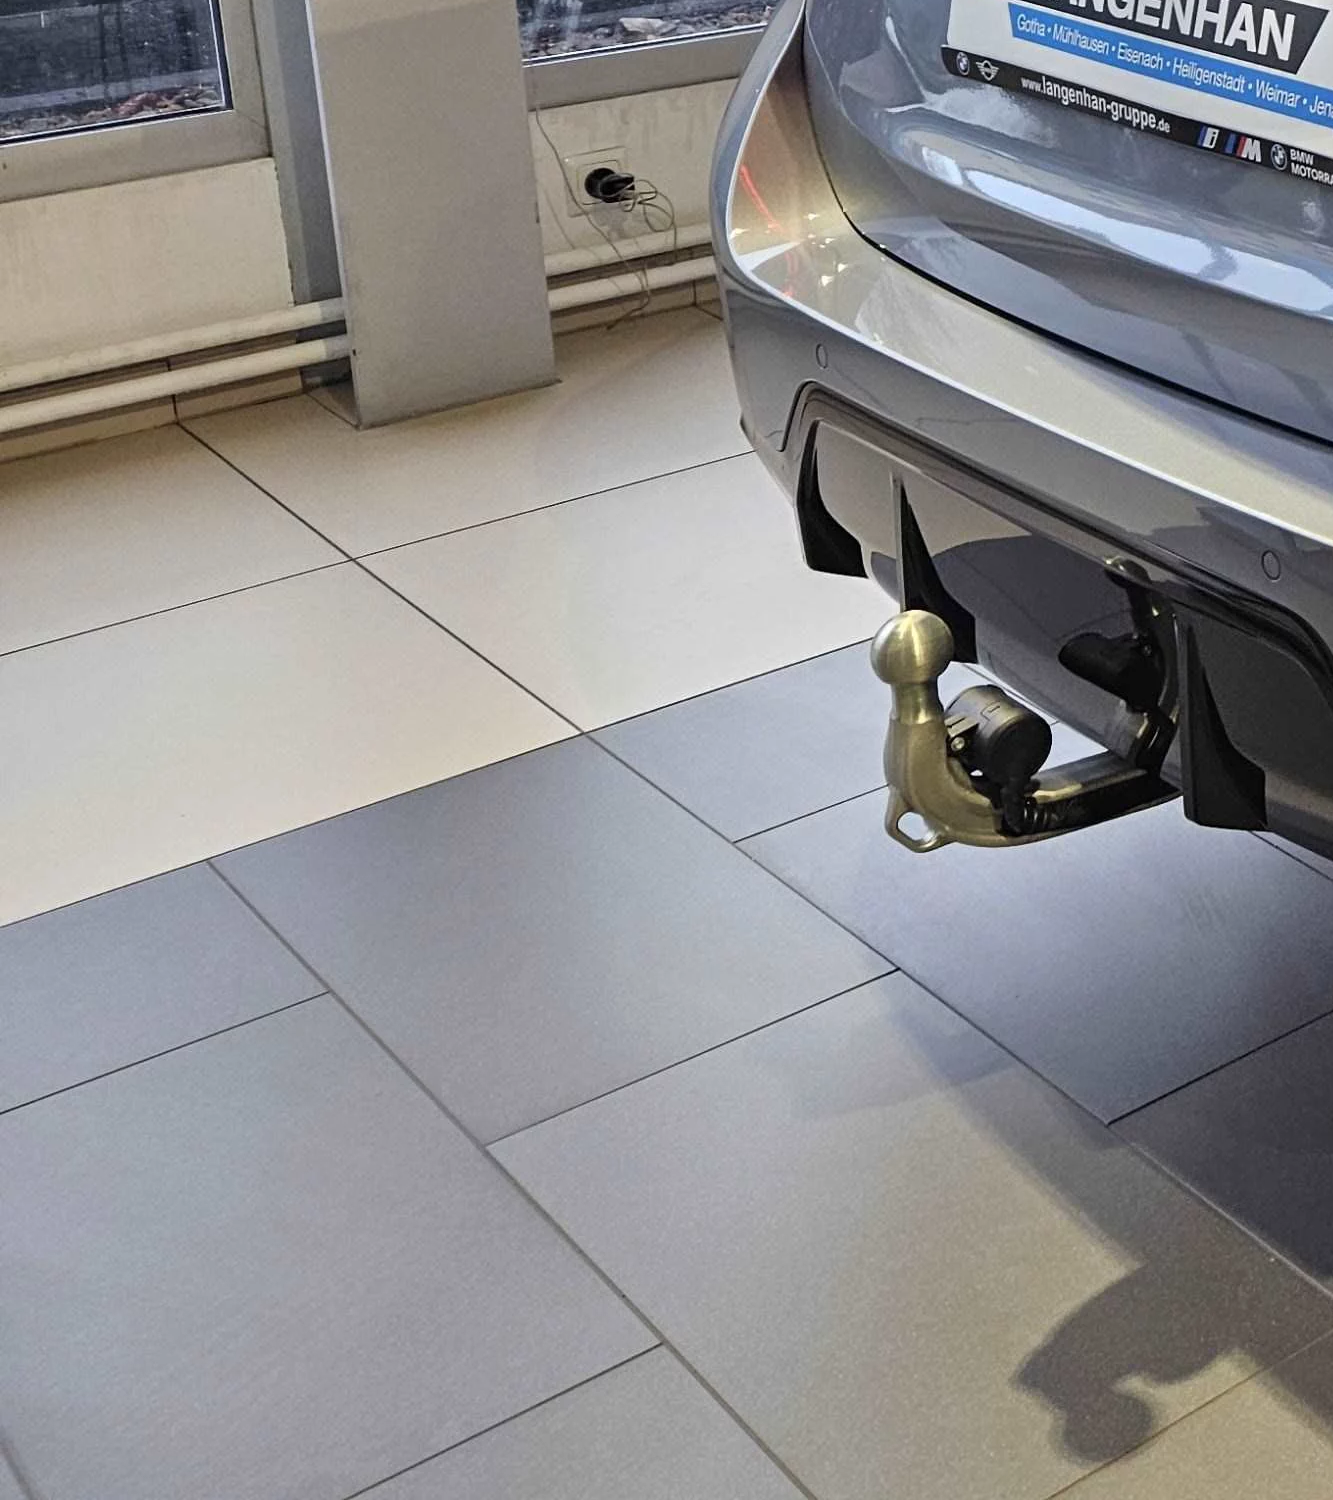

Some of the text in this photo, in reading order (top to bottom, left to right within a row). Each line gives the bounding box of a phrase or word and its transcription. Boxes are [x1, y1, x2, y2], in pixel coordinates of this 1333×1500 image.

[1016, 13, 1046, 37] Gotha
[1052, 23, 1110, 56] Mühlhausen
[1117, 42, 1163, 71] Eisenach
[1171, 57, 1246, 94] Heiligenstadt
[1255, 78, 1300, 108] Weimar
[1020, 75, 1171, 134] www.langenhan-gruppe.de
[1290, 148, 1315, 166] BMW
